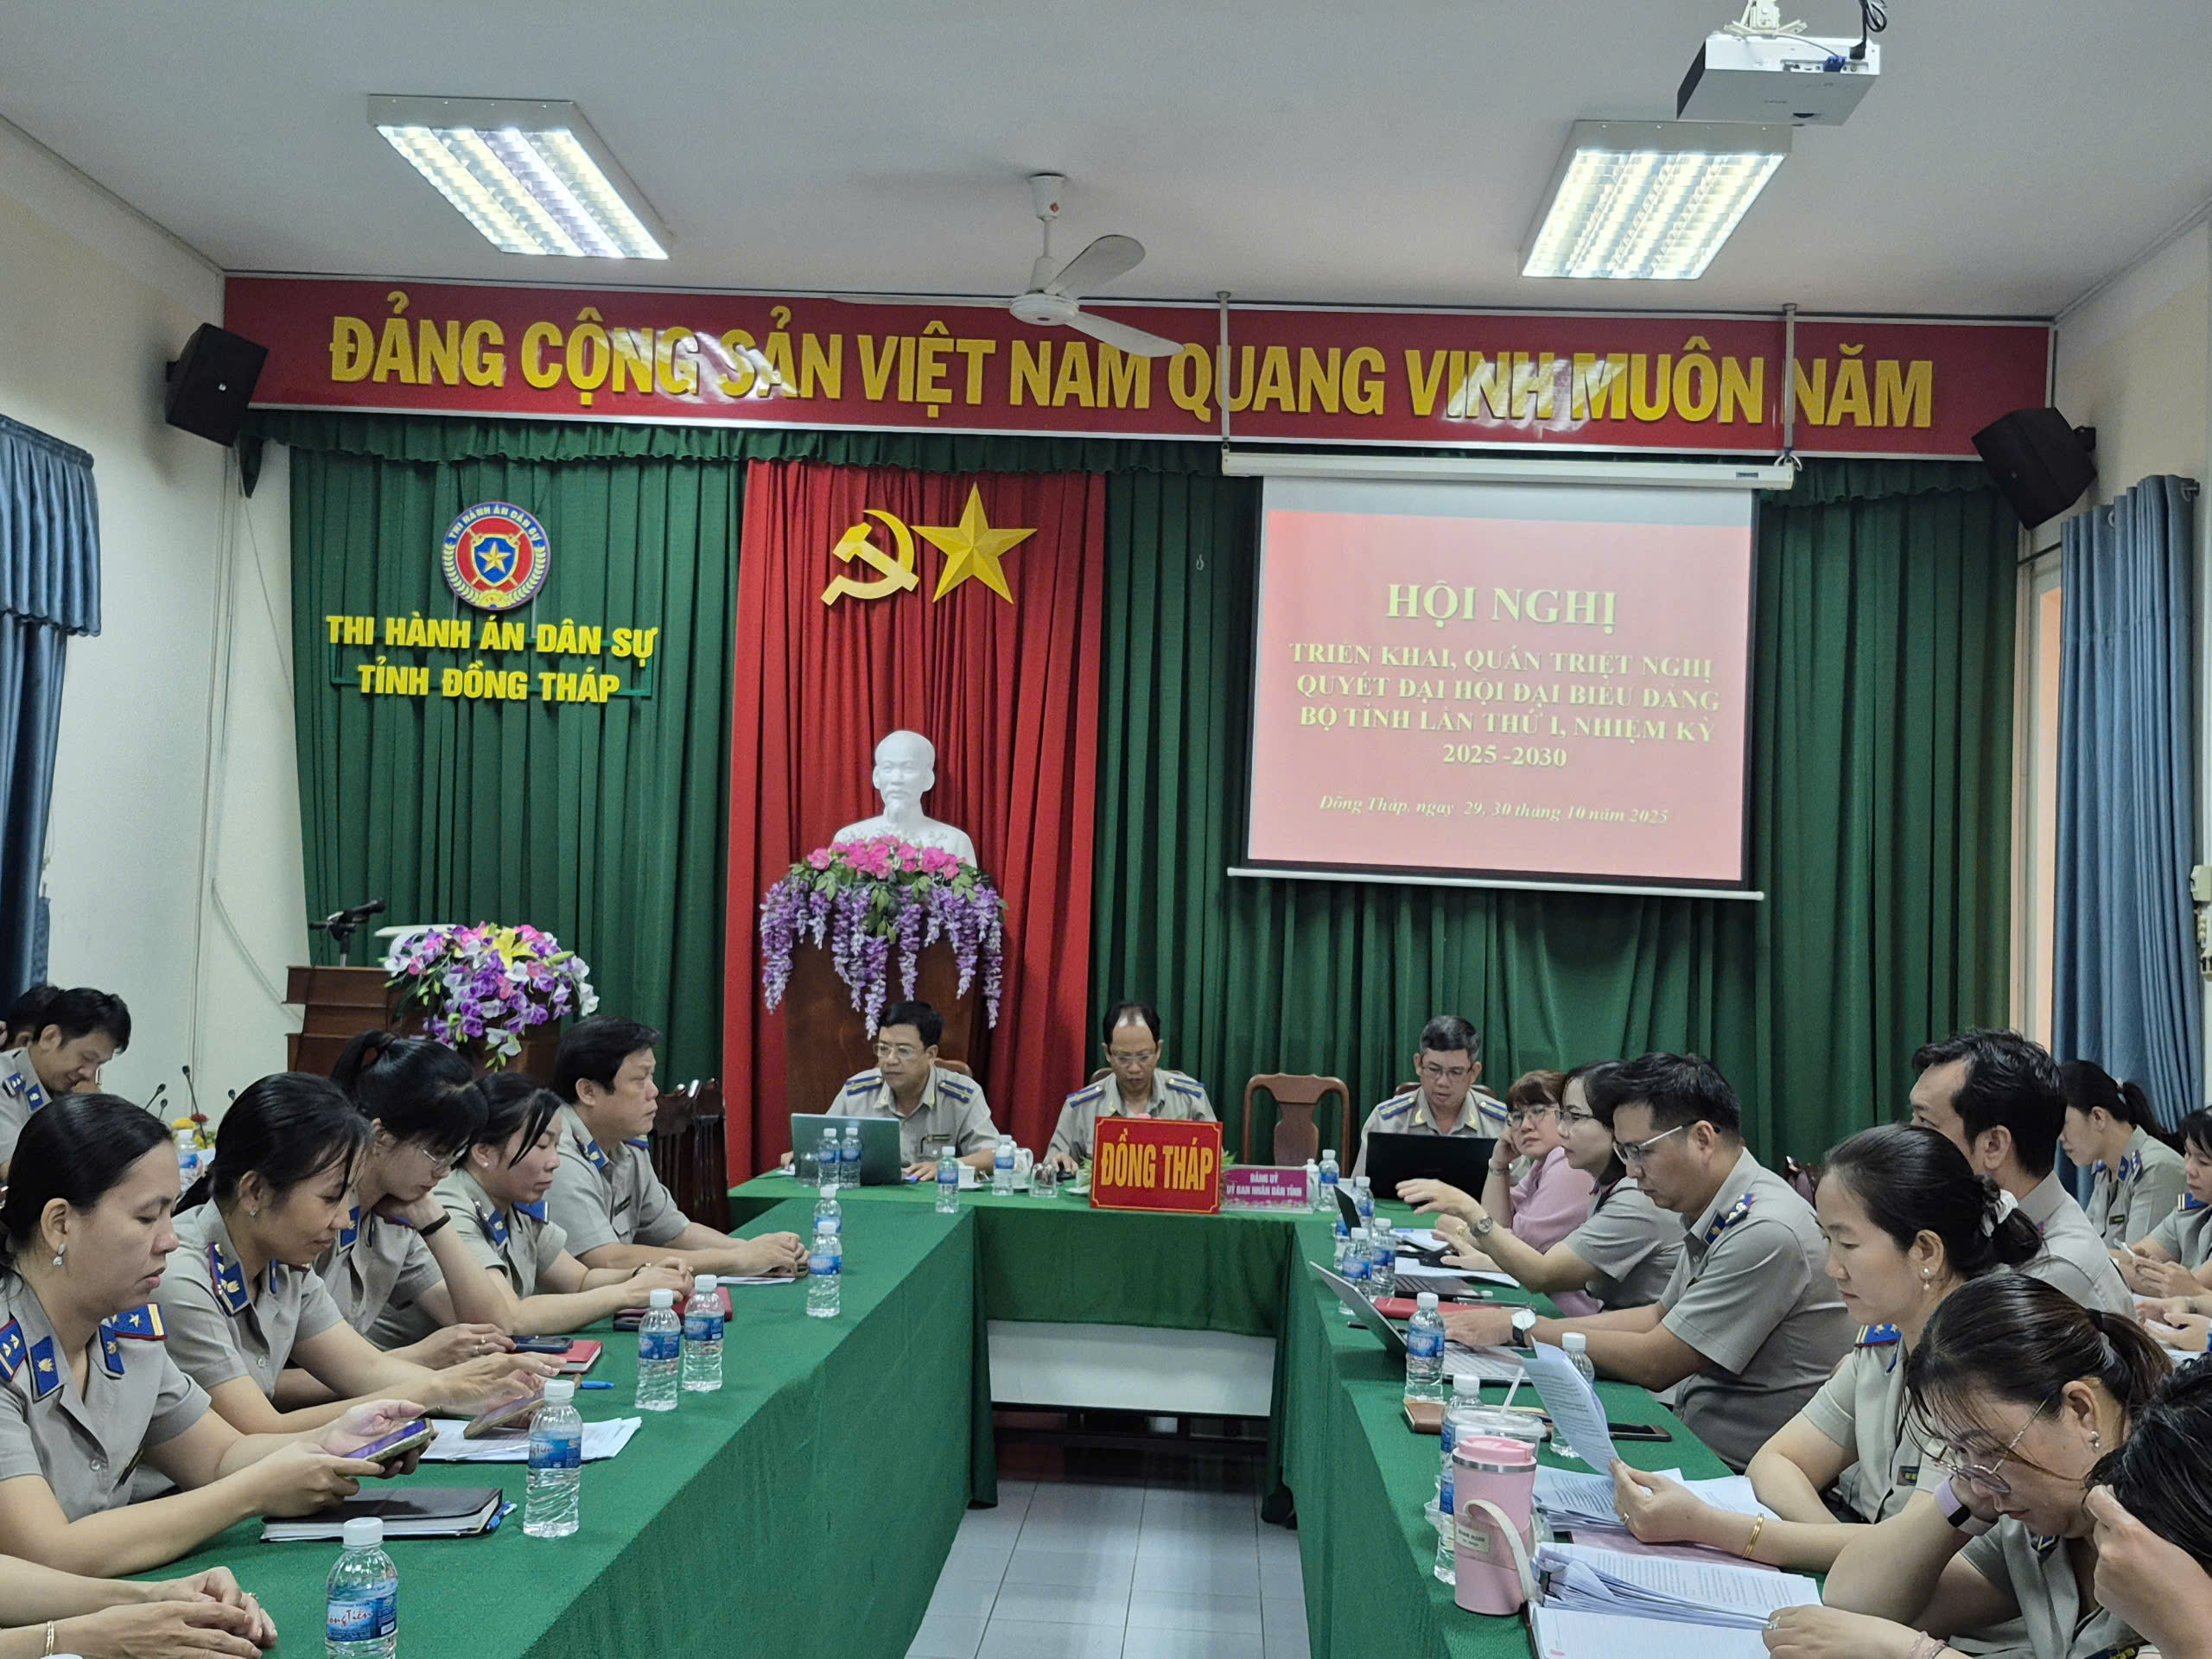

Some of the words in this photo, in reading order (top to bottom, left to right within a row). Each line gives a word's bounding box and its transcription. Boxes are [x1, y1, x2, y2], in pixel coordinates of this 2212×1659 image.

[329, 290, 505, 388] ĐẢNG
[520, 308, 698, 405] CỘNG
[714, 305, 842, 401] SẢN
[857, 320, 995, 418] VIỆT
[1010, 339, 1150, 410] NAM
[1168, 342, 1385, 422] QUANG
[1404, 349, 1557, 421] VINH
[1572, 335, 1764, 424] MUÔN
[1783, 343, 1933, 429] NĂM
[448, 522, 464, 538] THI
[462, 507, 491, 524] HÀNH
[493, 505, 509, 515] ÁN
[1386, 580, 1477, 629] HỘI
[1491, 587, 1618, 634] NGHỊ
[326, 615, 374, 645] THI
[385, 611, 471, 649] HÀNH
[480, 614, 524, 652] ÁN
[536, 619, 601, 655] DÂN
[611, 626, 658, 667] SỰ
[357, 655, 429, 696] TỈNH
[442, 659, 528, 700] ĐỒNG
[538, 666, 620, 702] THÁP
[1381, 646, 1457, 671] KHAI,
[1465, 645, 1541, 672] QUÁN
[1549, 651, 1632, 679] TRIỆT
[1642, 657, 1712, 683] NGHỊ
[1297, 671, 1390, 698] QUYẾT
[1399, 678, 1445, 704] ĐẠI
[1454, 678, 1503, 705] HỘI
[1513, 683, 1560, 709] ĐẠI
[1300, 704, 1338, 732] BỘ
[1344, 702, 1411, 729] TỈNH
[1483, 708, 1543, 734] THỨ
[1551, 715, 1567, 739] I,
[1573, 715, 1666, 744] NHIỆM
[1443, 744, 1497, 765] 2025
[1491, 802, 1512, 816] 30
[1630, 808, 1669, 823] 2025
[1100, 1128, 1157, 1188] ĐỒNG
[1162, 1137, 1213, 1191] THÁP
